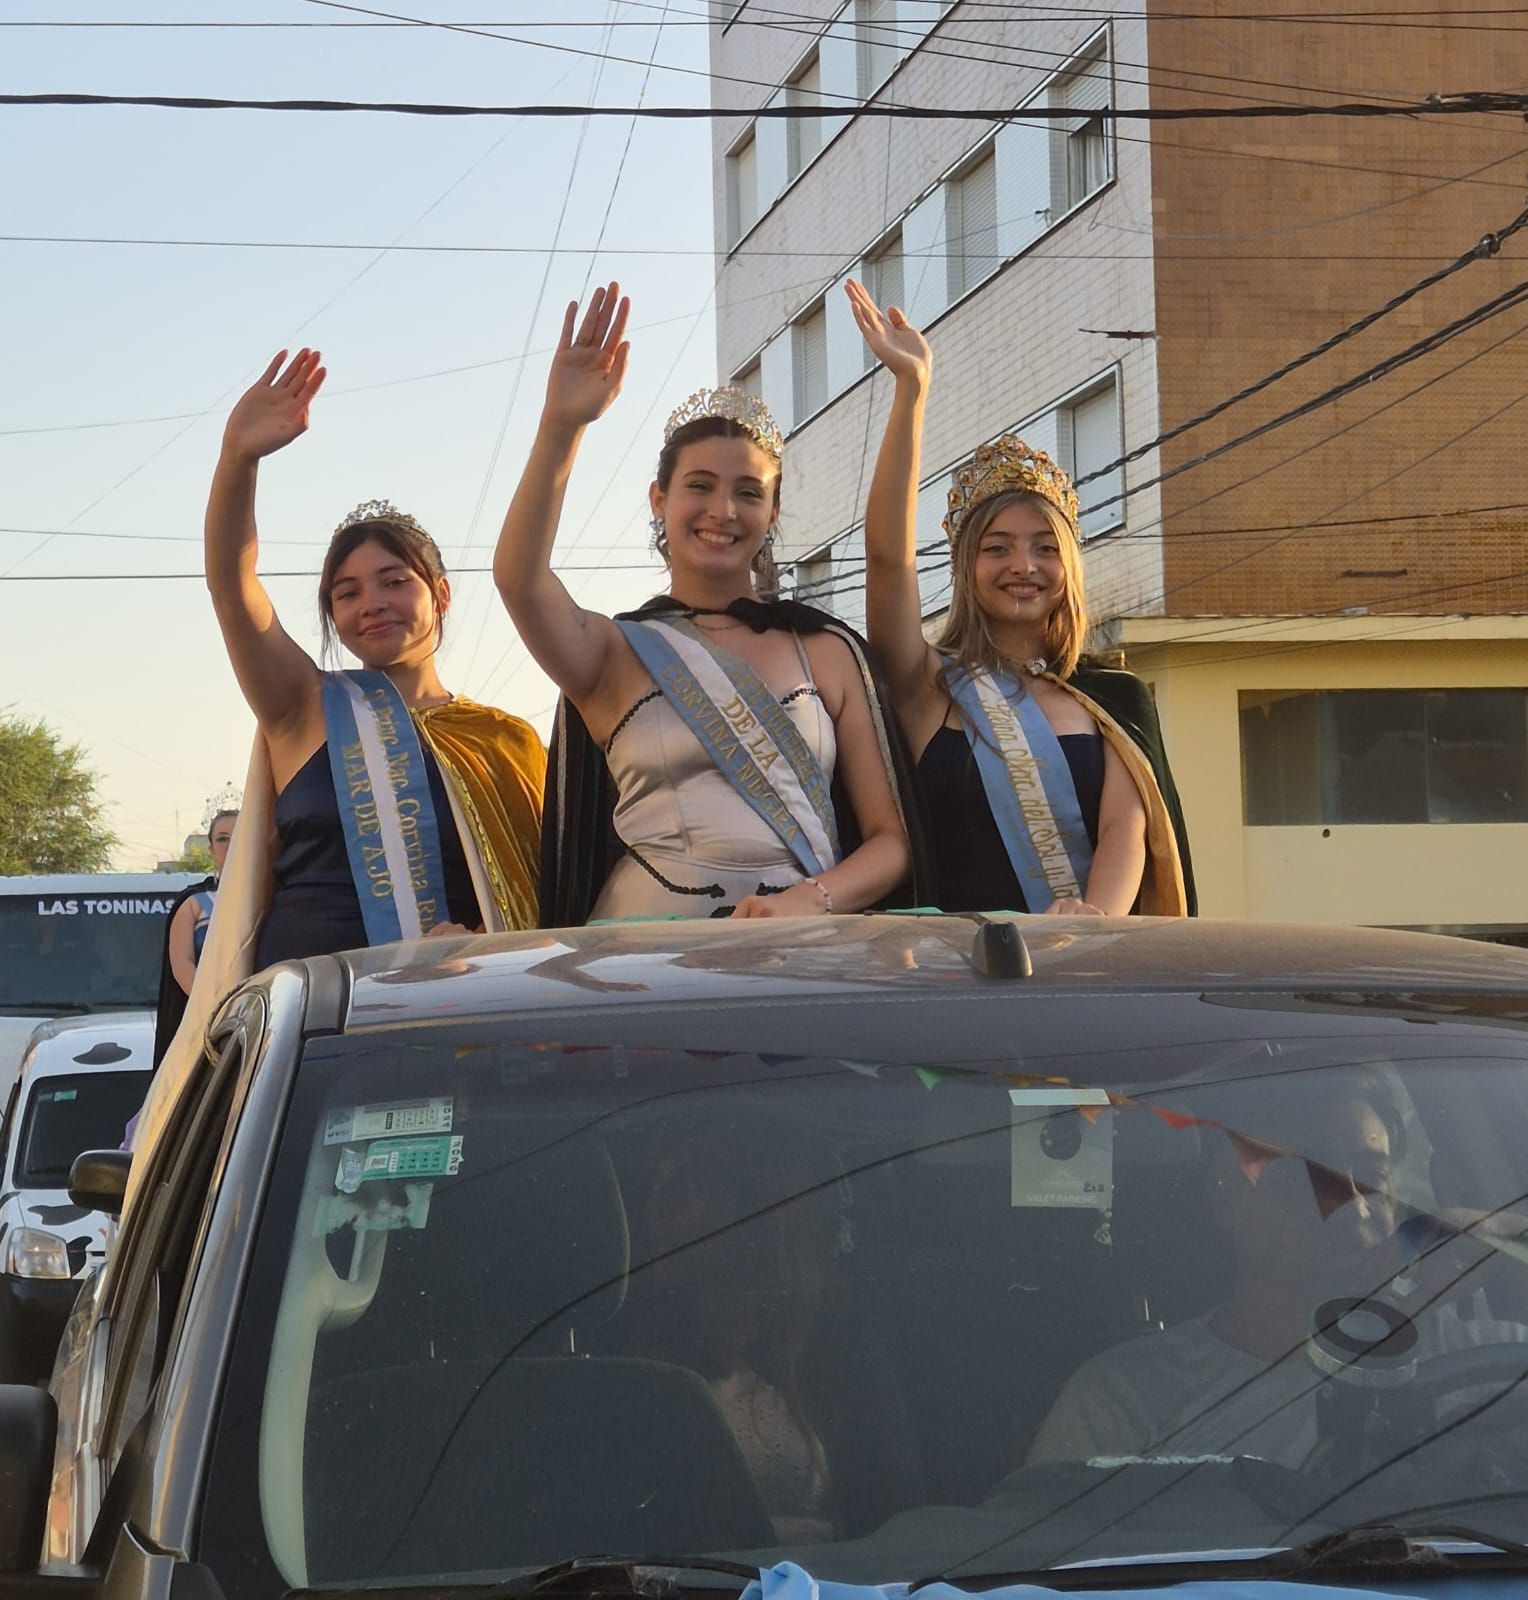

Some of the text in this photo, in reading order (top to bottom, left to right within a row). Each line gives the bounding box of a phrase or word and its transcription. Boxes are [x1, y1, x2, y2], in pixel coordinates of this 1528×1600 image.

[660, 661, 741, 761] CORVINA
[719, 695, 757, 735] DE
[747, 734, 781, 773] LA
[339, 741, 394, 900] MAR DE AJO
[395, 796, 429, 892] Corvina
[38, 899, 175, 915] LAS TONINAS
